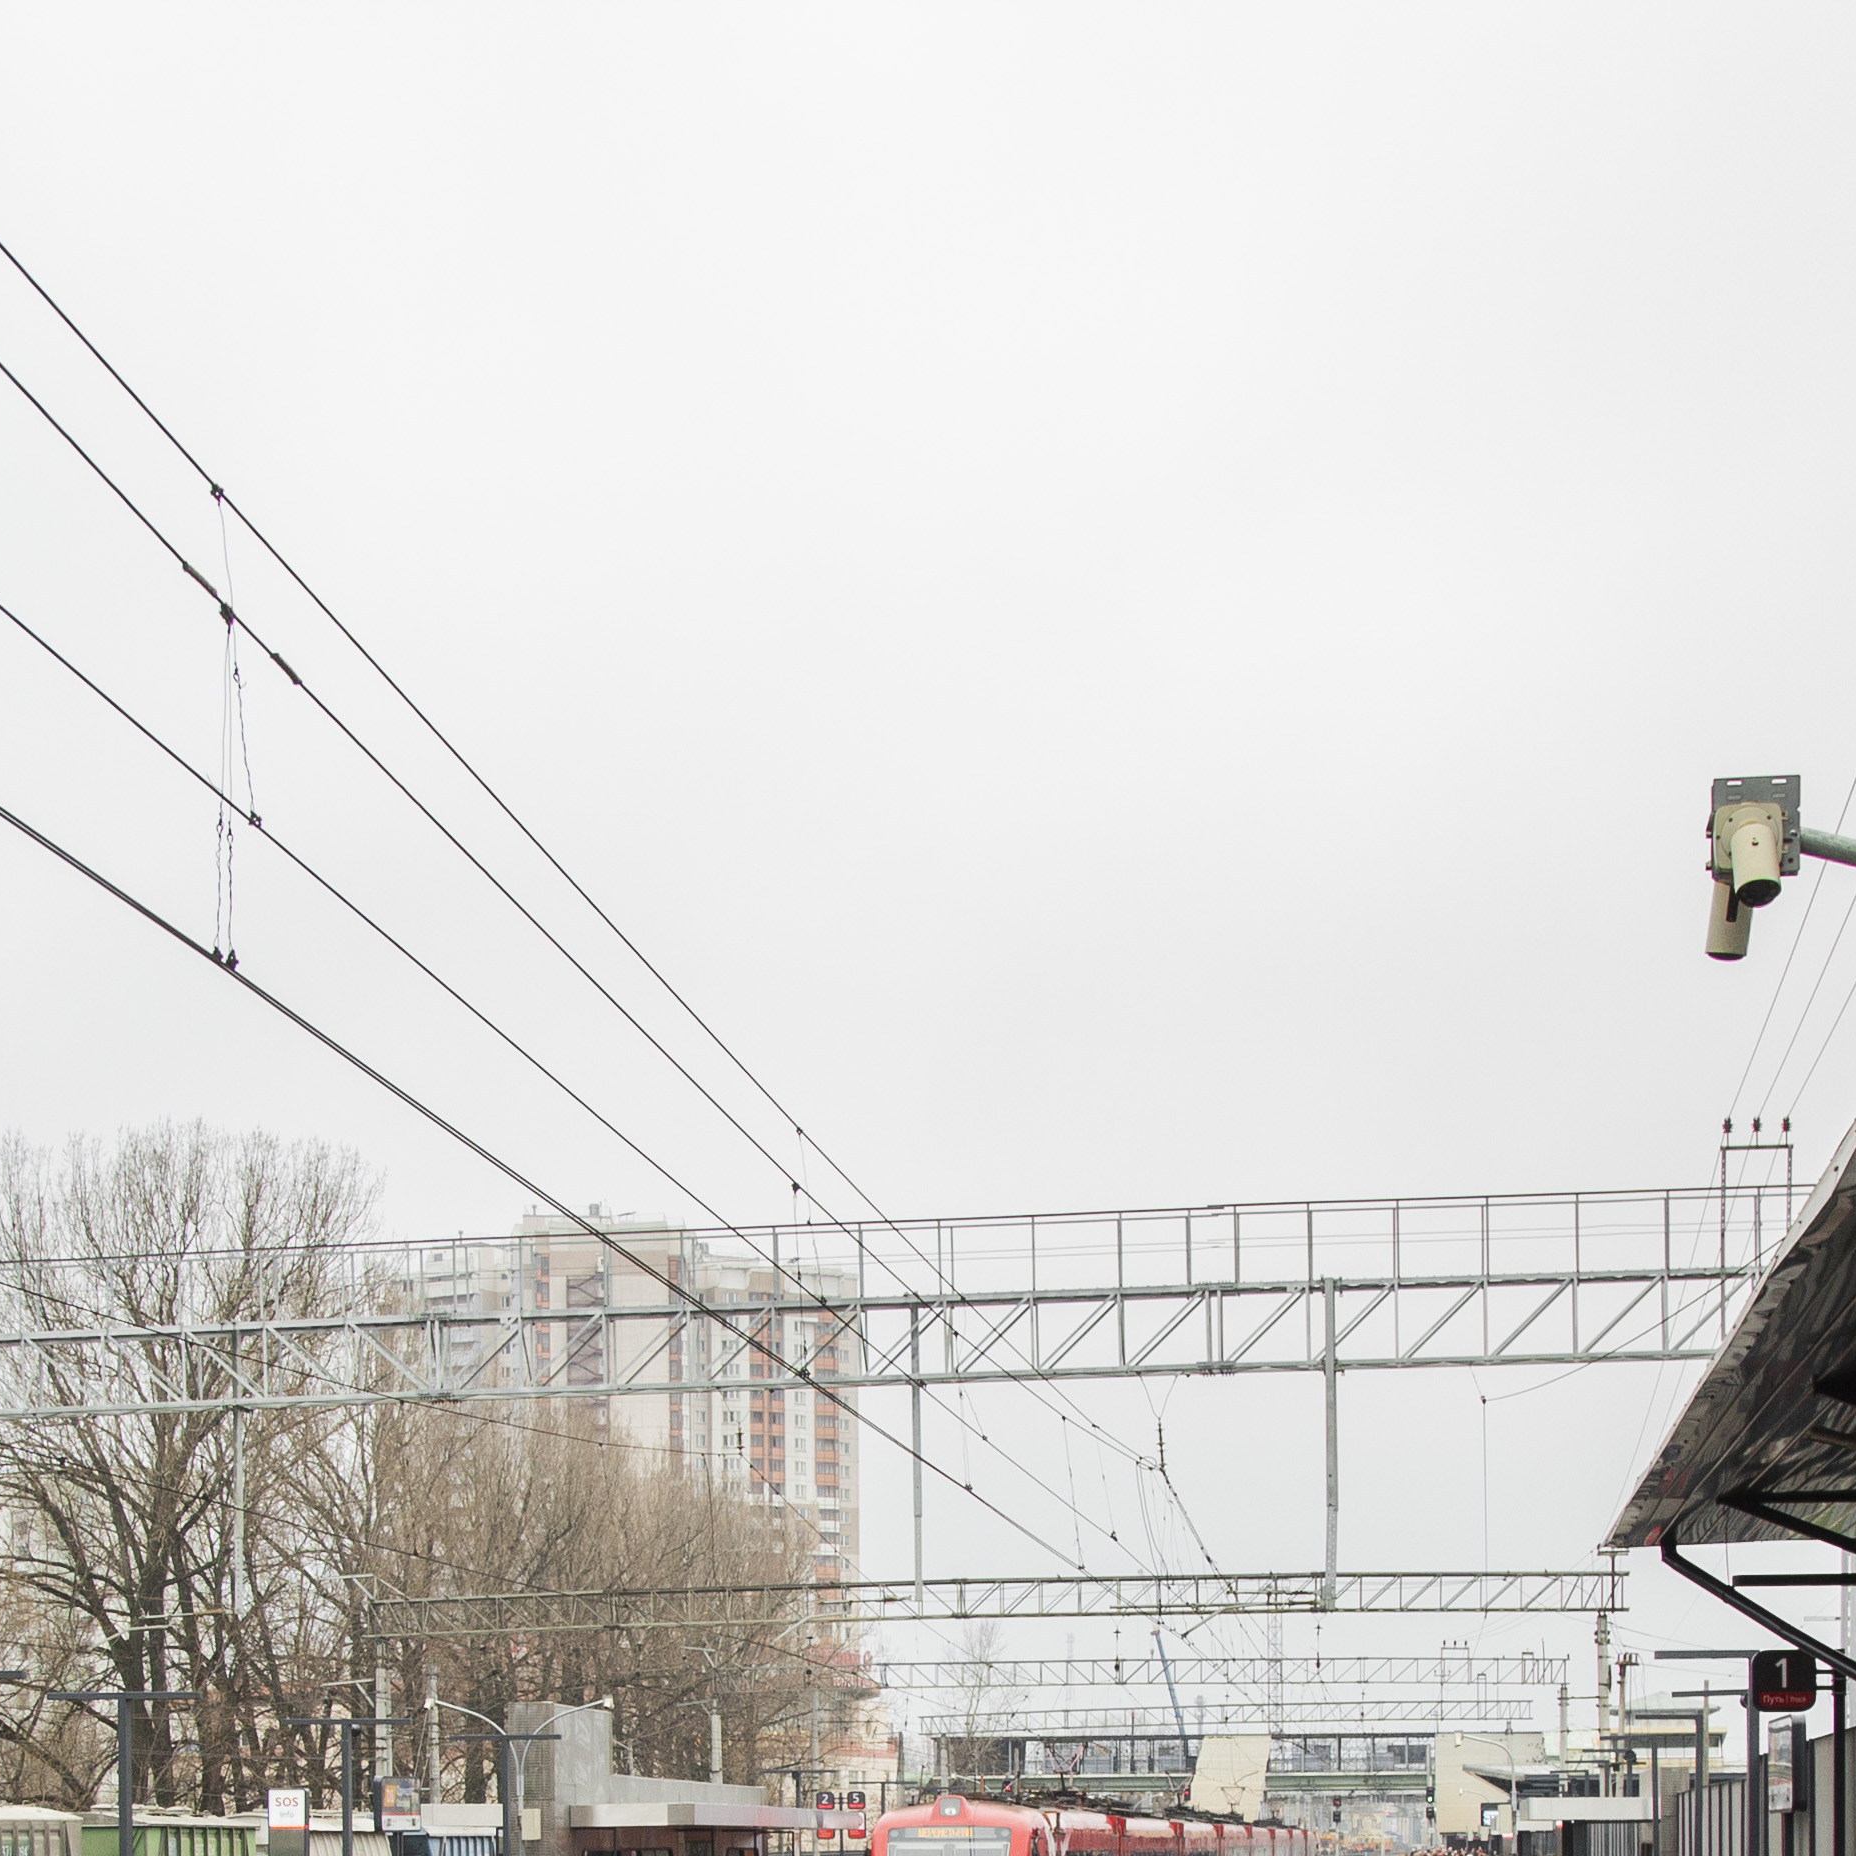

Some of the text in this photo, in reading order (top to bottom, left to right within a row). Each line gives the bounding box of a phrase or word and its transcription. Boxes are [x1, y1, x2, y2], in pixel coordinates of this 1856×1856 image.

[1774, 1657, 1788, 1689] 1
[1763, 1694, 1785, 1706] Путь
[275, 1796, 299, 1807] SOS
[821, 1793, 829, 1804] 2
[852, 1791, 860, 1803] 5
